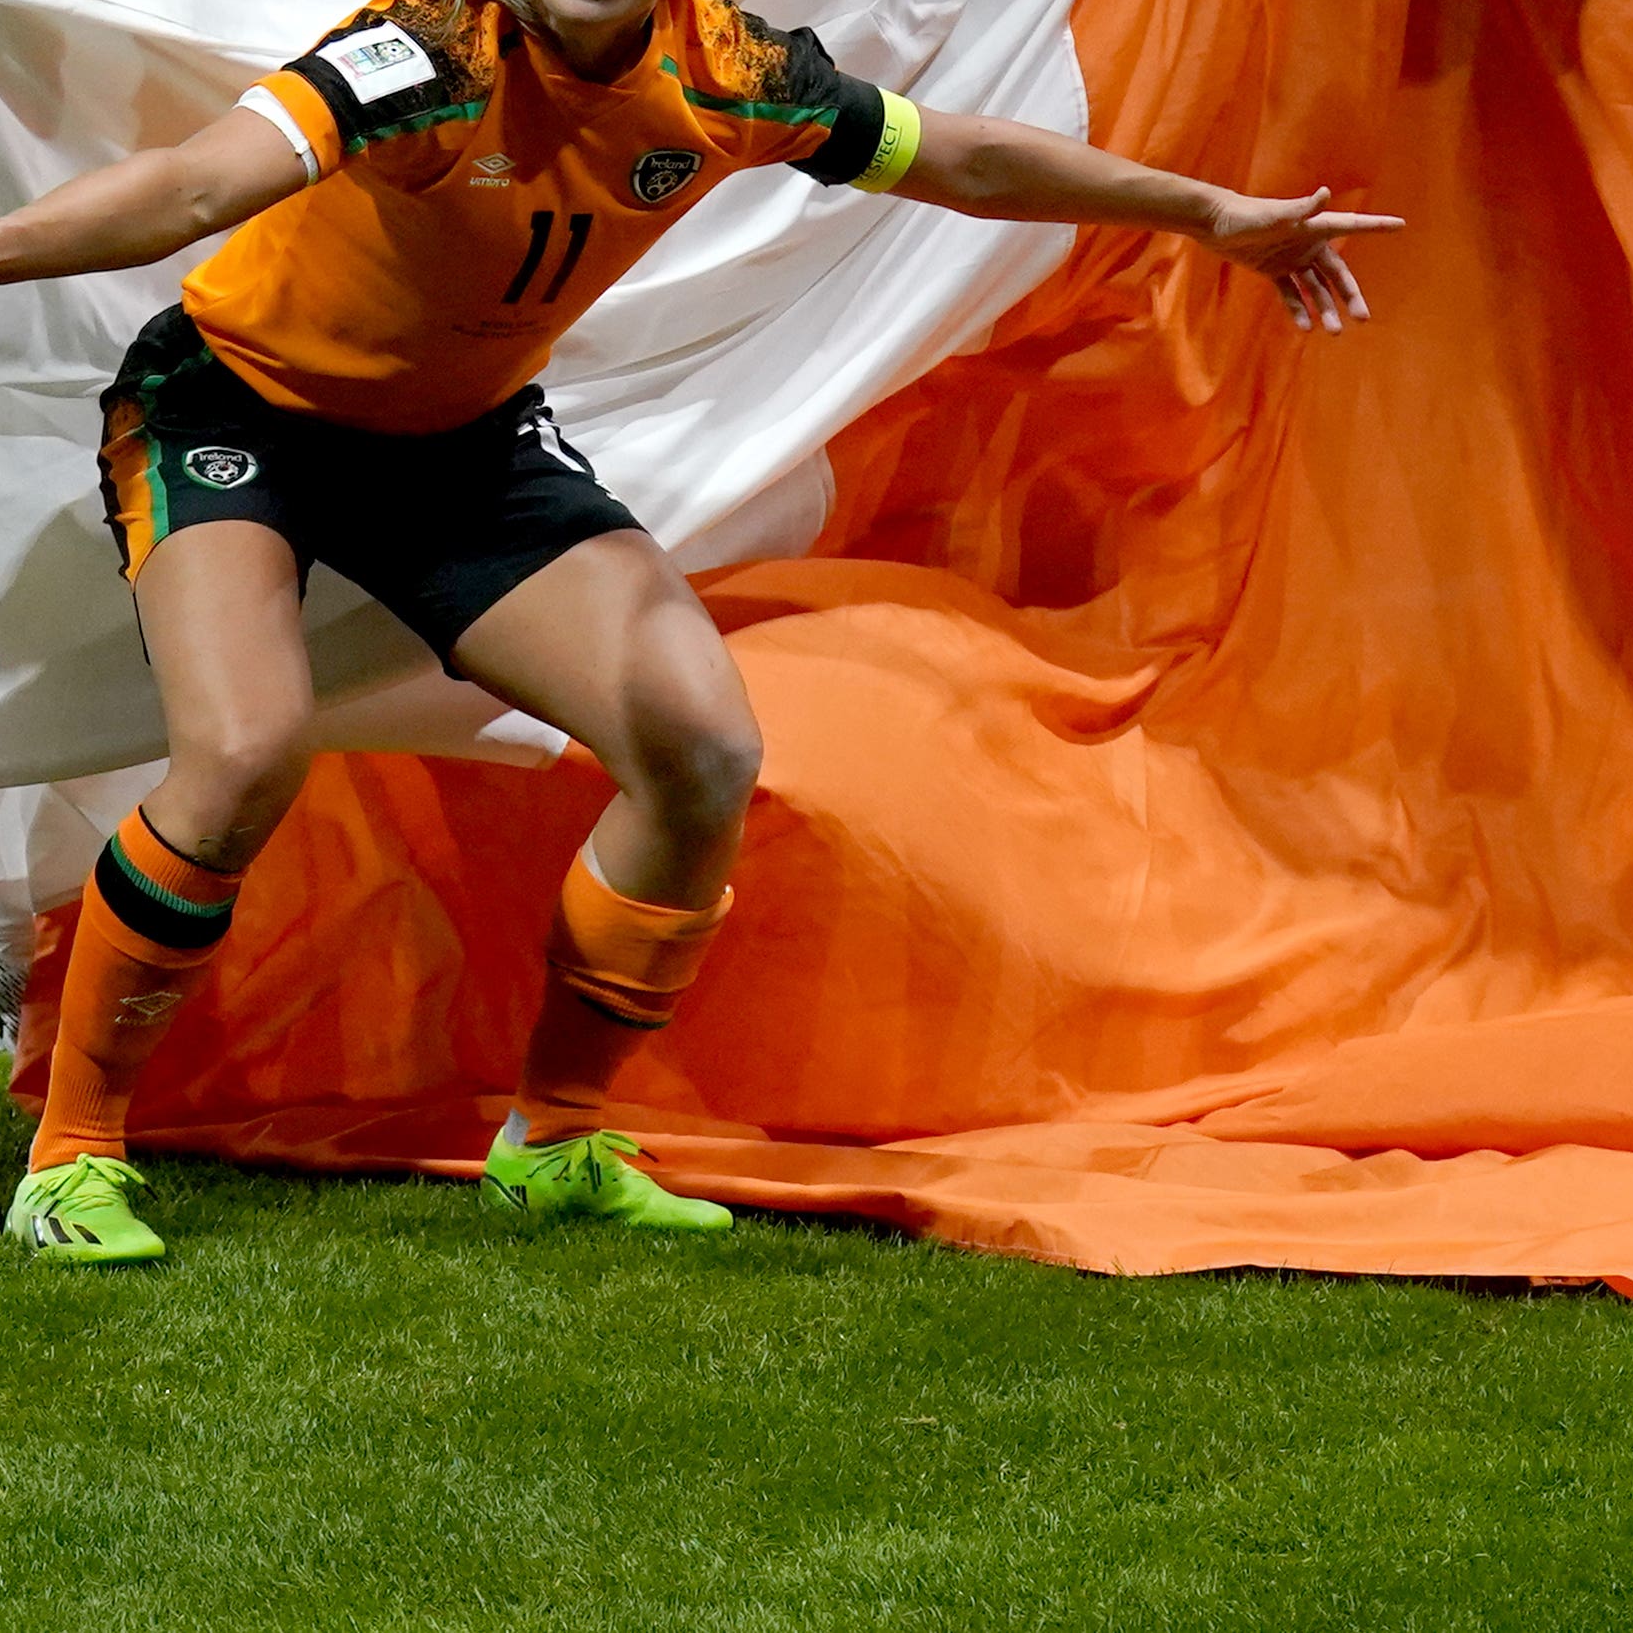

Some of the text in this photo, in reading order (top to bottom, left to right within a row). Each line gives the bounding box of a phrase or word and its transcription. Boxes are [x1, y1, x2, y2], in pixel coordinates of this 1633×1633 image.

[650, 157, 691, 169] Ireland
[469, 176, 510, 187] umbro
[500, 211, 594, 304] 11
[198, 452, 243, 463] Ireland
